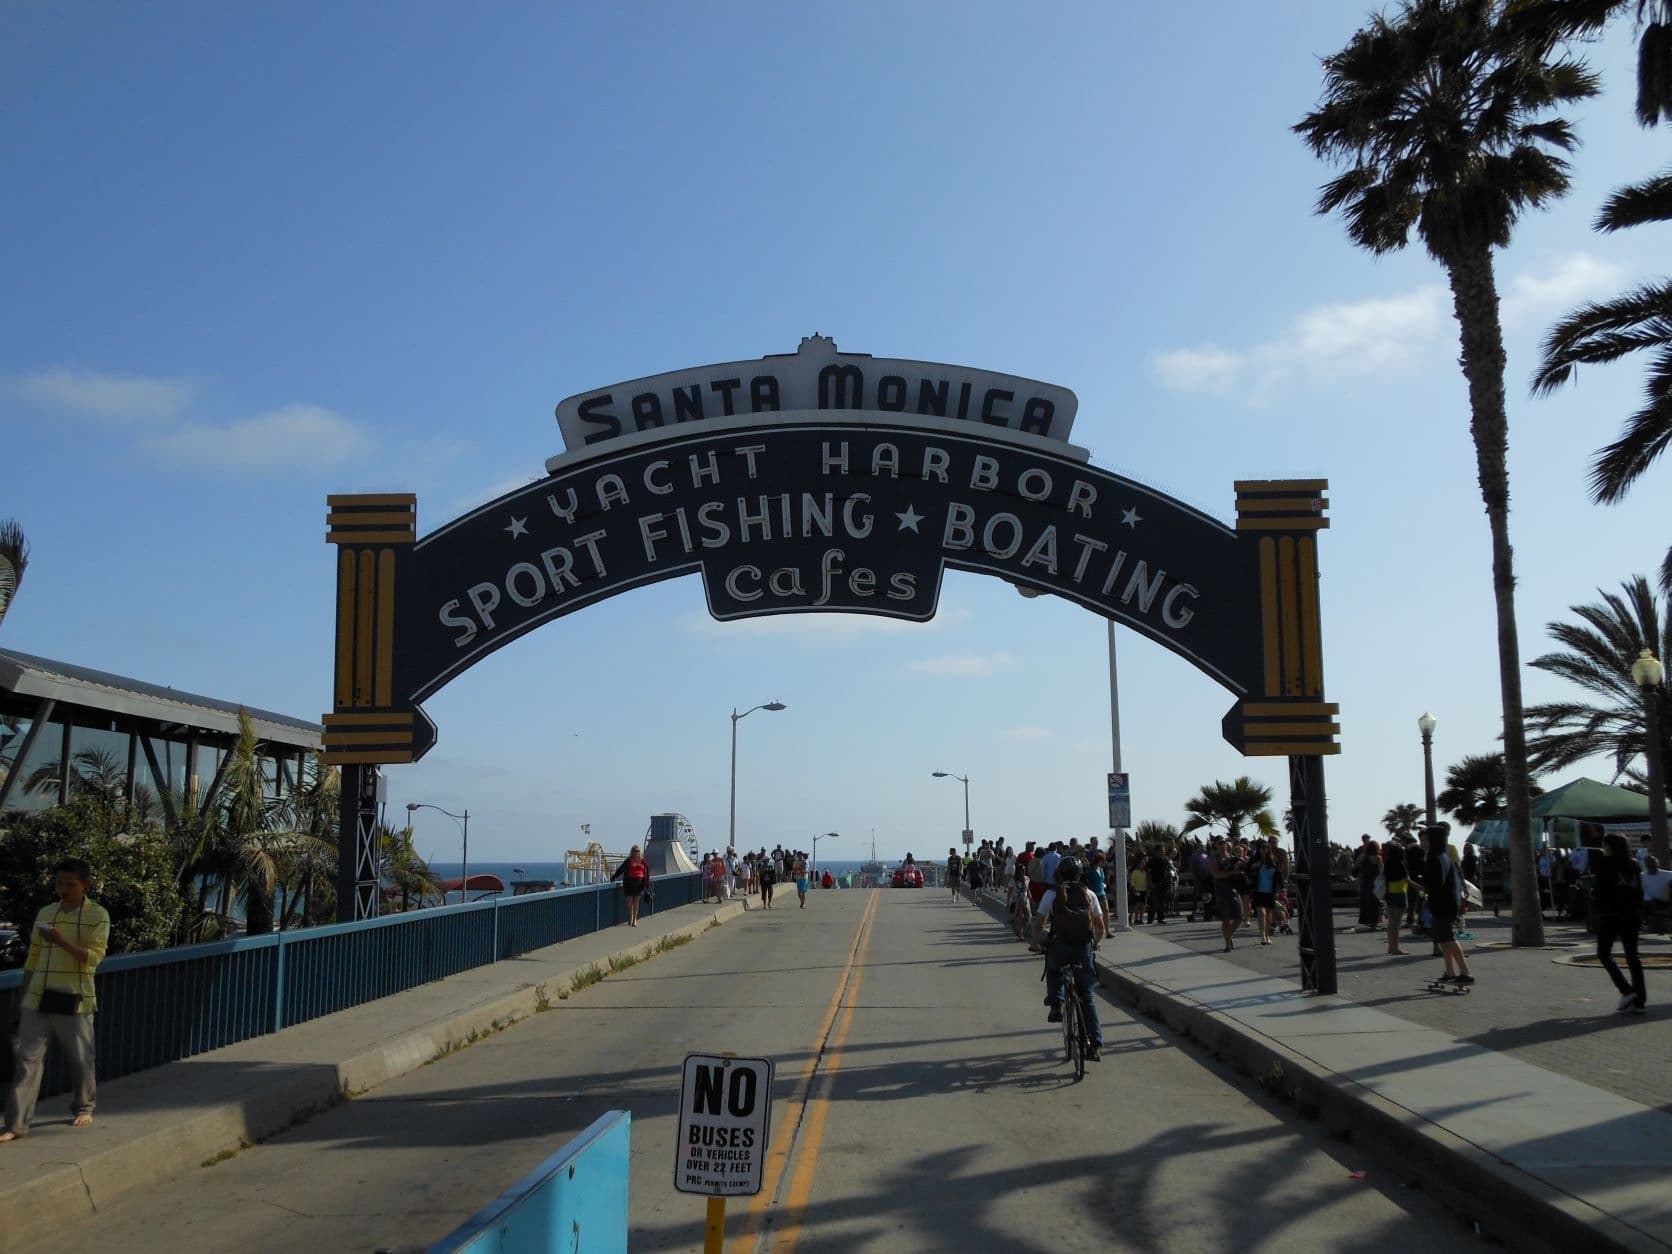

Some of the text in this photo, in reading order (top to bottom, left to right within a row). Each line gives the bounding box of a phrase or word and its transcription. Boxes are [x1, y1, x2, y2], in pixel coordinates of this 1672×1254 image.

[577, 363, 1055, 445] SANTA MONICA
[547, 441, 1098, 524] YACHT HARBOR
[438, 492, 1200, 648] SPORT FISHING BOATING
[693, 1064, 757, 1118] NO
[688, 1124, 755, 1148] BUSES
[690, 1147, 751, 1160] OR VEHICLES
[686, 1159, 753, 1173] OVER 22 FEET
